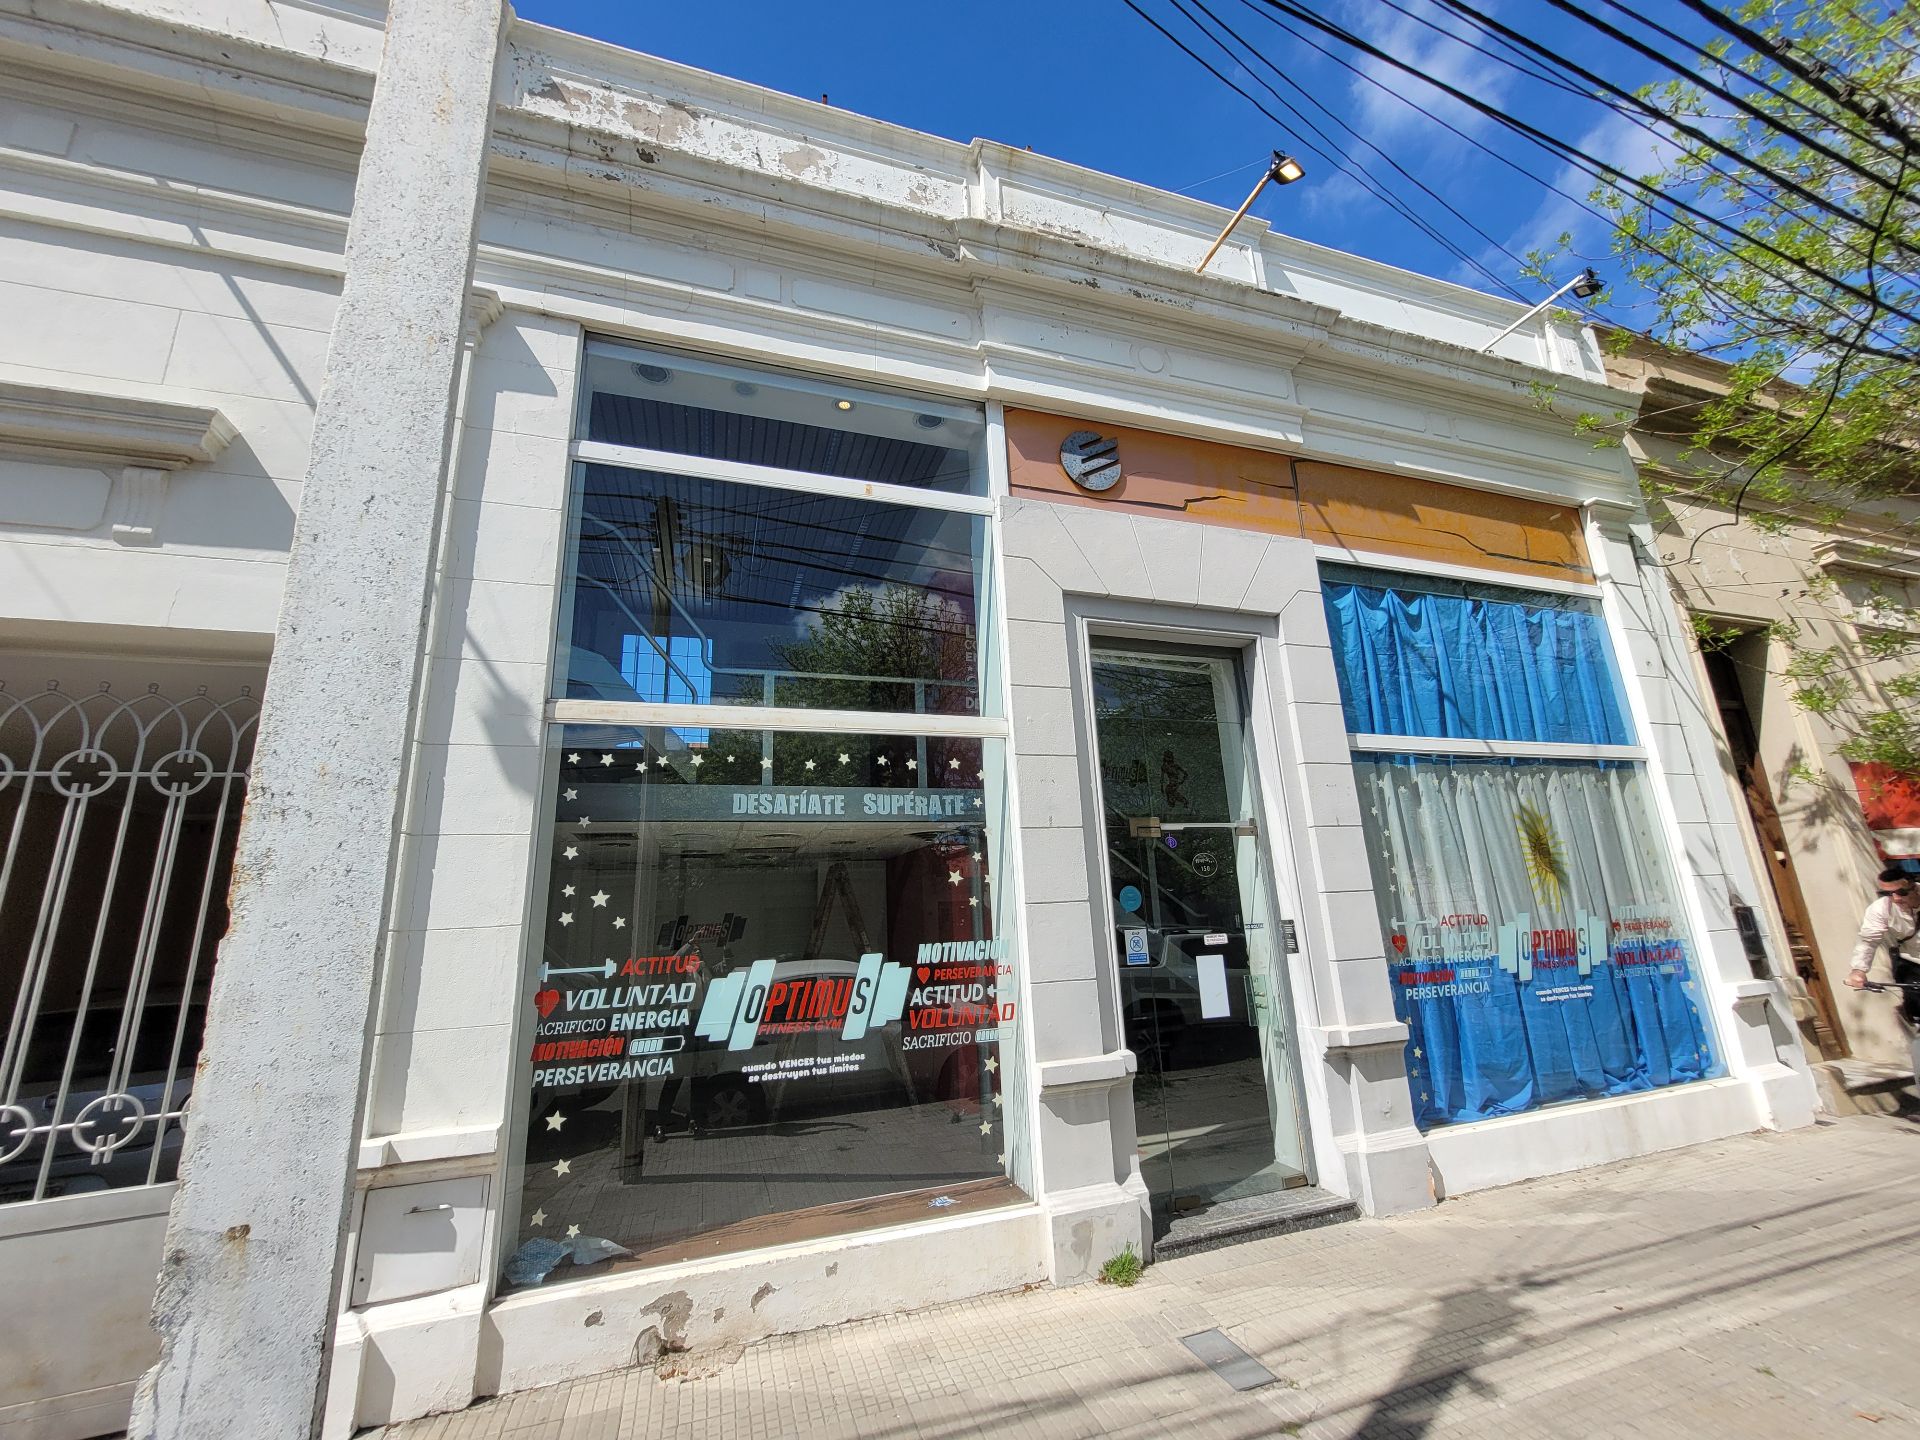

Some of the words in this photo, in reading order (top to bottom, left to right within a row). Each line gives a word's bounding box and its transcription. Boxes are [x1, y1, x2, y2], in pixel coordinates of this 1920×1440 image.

[732, 790, 845, 815] DESAFÍATE
[863, 791, 965, 816] SUPÉRATE
[1440, 914, 1488, 927] ACTITUD
[1521, 927, 1587, 961] OPTIMUS
[619, 953, 700, 977] ACTITUD
[934, 964, 1012, 981] PERSEVERANCIA
[566, 982, 697, 1012] VOLUNTAD
[743, 977, 871, 1024] OPTIMUS
[909, 984, 984, 1007] ACTITUD
[1405, 981, 1491, 1001] PERSEVERANCIA
[533, 1018, 606, 1036] ACRIFICIO
[610, 1008, 690, 1032] ENERGIA
[757, 1021, 811, 1036] FITNESS
[815, 1018, 843, 1031] GYM
[909, 1002, 1015, 1030] VOLUNTAD
[902, 1031, 972, 1051] SACRIFICIO
[532, 1057, 674, 1088] PERSEVERANCIA
[742, 1061, 776, 1073] cuando
[778, 1057, 814, 1069] VENCES
[816, 1056, 832, 1065] tus
[833, 1053, 866, 1063] miedos
[748, 1074, 760, 1083] se
[762, 1068, 810, 1082] destruyen
[812, 1066, 827, 1076] tus
[829, 1063, 859, 1075] límites
